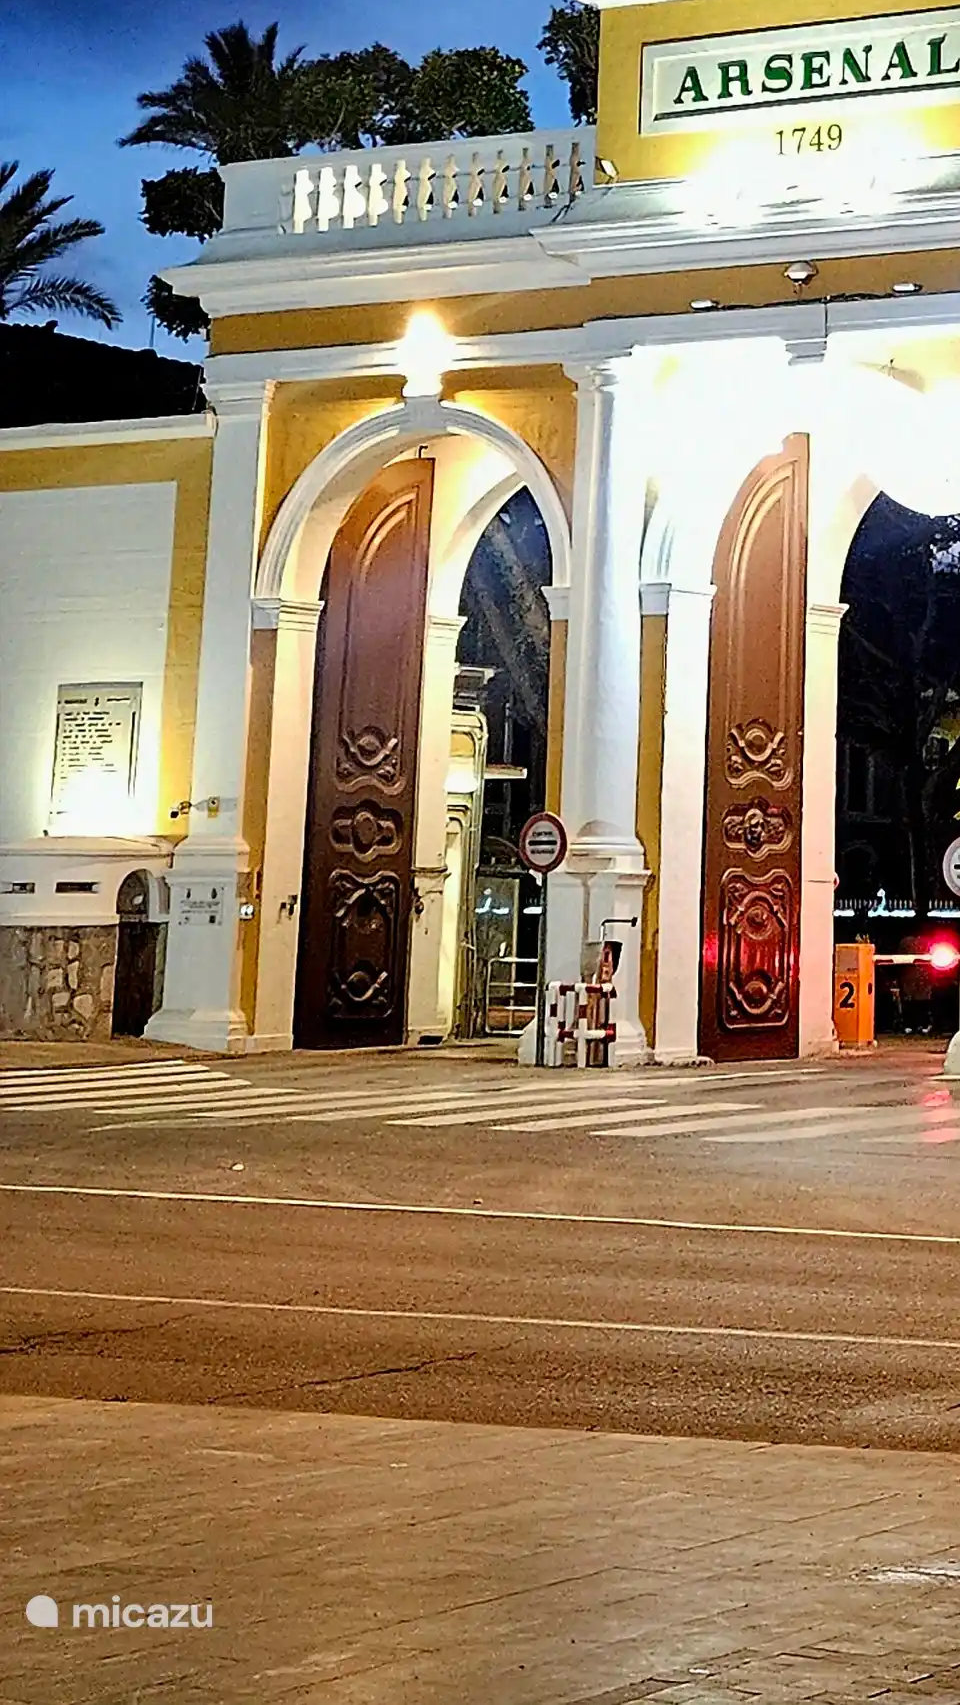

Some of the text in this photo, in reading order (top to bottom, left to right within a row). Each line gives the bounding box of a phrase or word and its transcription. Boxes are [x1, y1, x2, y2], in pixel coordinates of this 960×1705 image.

[673, 33, 960, 105] ARSENAL
[775, 124, 843, 155] 1749
[839, 981, 856, 1009] 2
